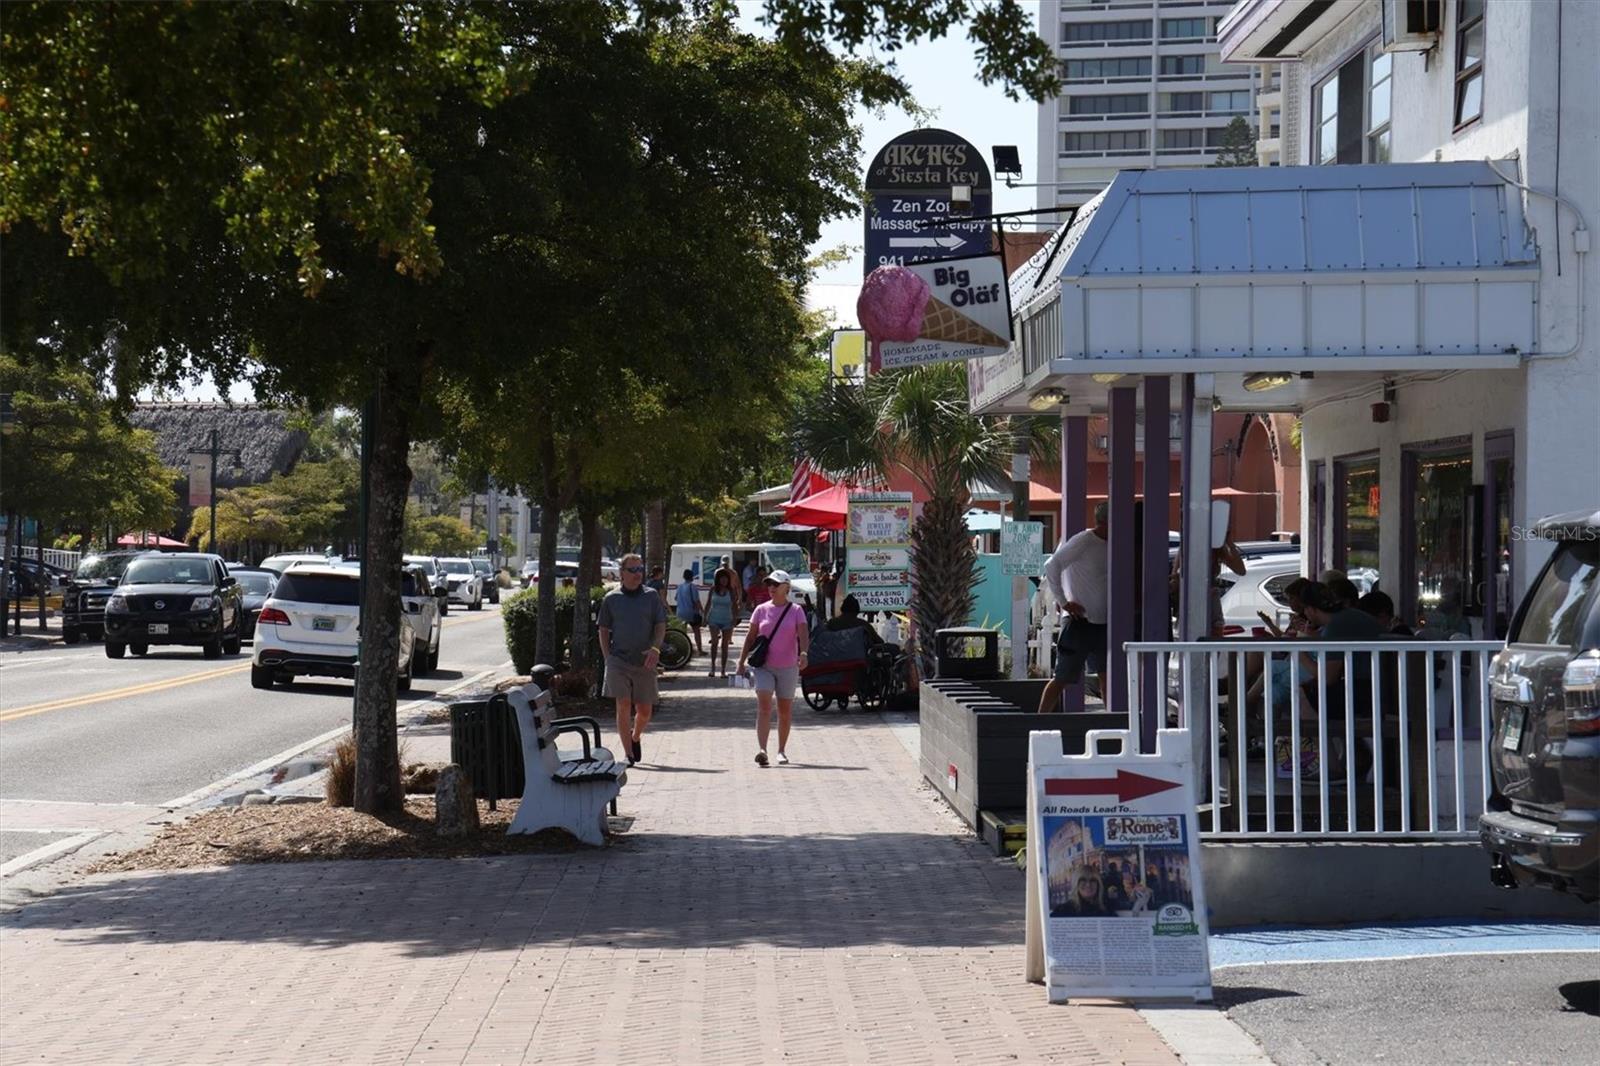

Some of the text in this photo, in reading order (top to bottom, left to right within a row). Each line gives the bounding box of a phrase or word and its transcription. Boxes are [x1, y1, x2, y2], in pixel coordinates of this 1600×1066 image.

[884, 144, 967, 167] ARCHES
[888, 166, 940, 183] Siesta
[946, 166, 979, 186] Key
[892, 199, 921, 213] Zen
[934, 266, 970, 287] Big
[883, 343, 942, 357] HOMEMADE
[885, 357, 902, 366] ICE
[902, 352, 938, 364] CREAM
[953, 347, 985, 358] CONES
[1043, 805, 1058, 814] All
[1059, 806, 1090, 814] Roads
[1093, 805, 1117, 814] Lead
[1120, 817, 1164, 835] Rome
